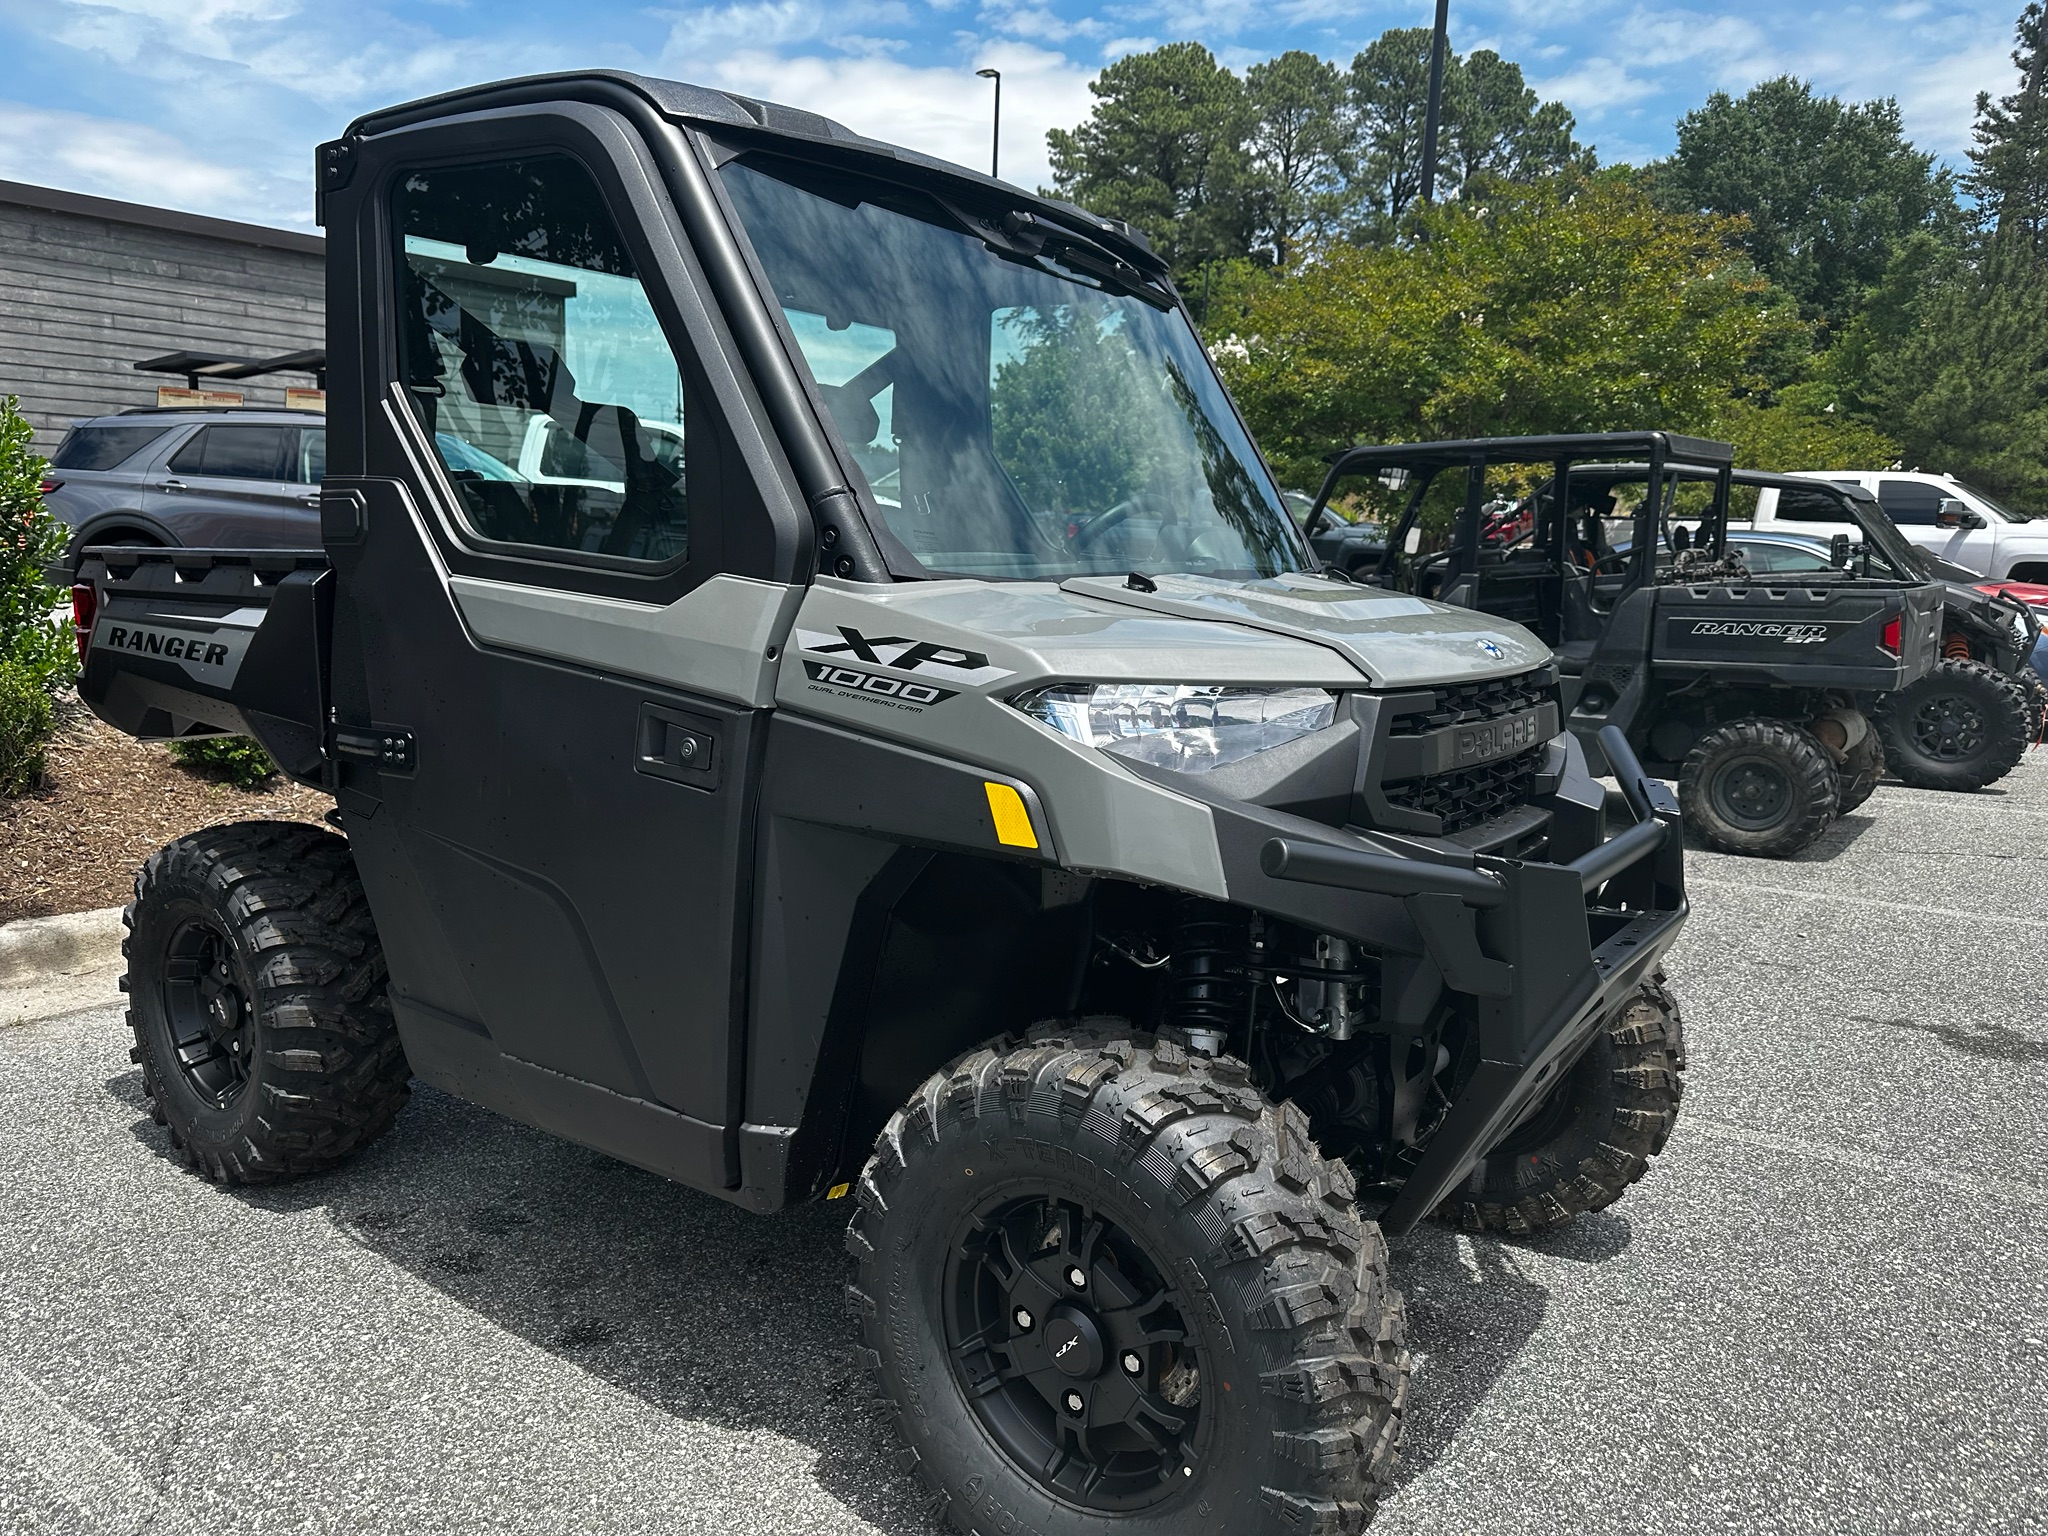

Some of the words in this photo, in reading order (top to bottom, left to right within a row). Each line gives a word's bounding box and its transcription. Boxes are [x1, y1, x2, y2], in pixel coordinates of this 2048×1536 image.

[108, 626, 229, 666] RANGER
[804, 625, 990, 670] XP
[1691, 622, 1827, 637] RANGER
[808, 684, 835, 695] DUAL
[837, 690, 897, 708] OVERHEAD
[897, 703, 923, 714] CAM
[816, 665, 940, 703] 1000
[1459, 715, 1538, 760] POLARIS
[980, 1136, 1153, 1224] X-TERRAIN
[1055, 1334, 1079, 1358] XP
